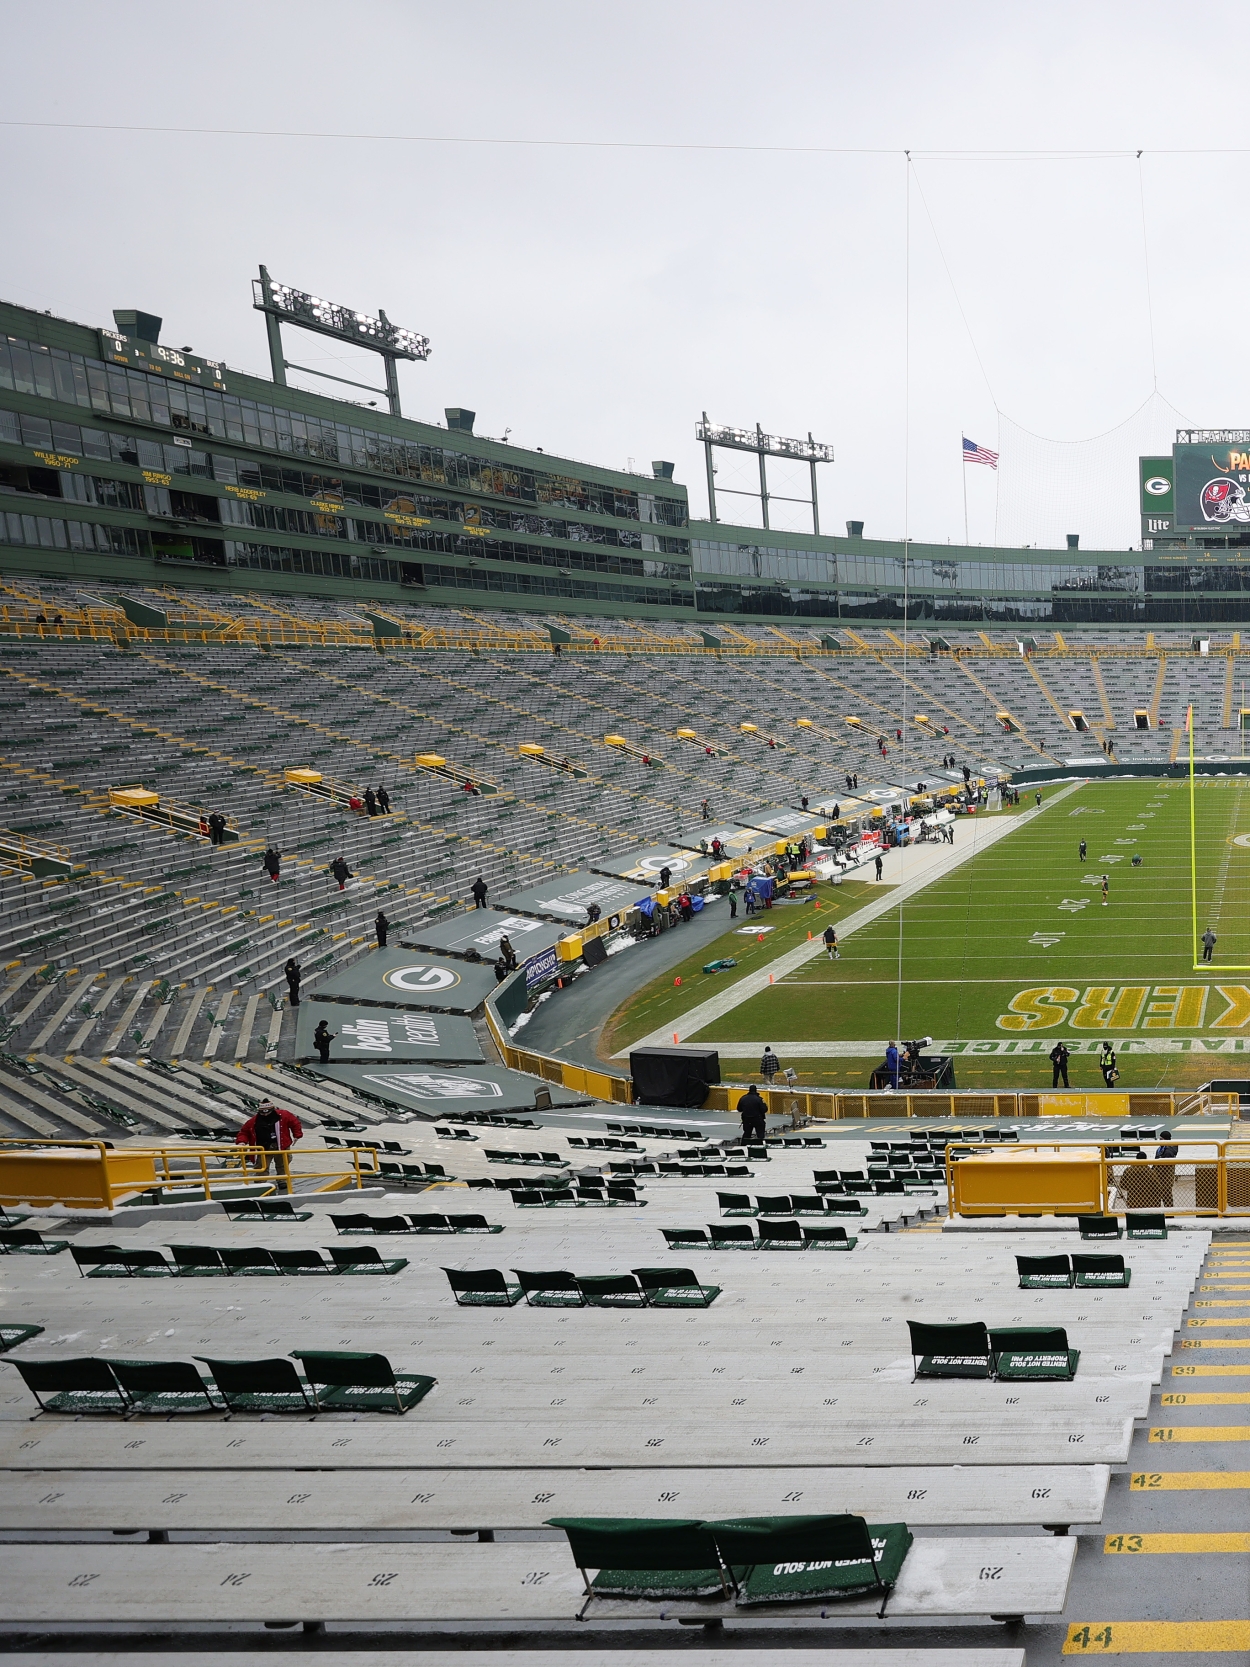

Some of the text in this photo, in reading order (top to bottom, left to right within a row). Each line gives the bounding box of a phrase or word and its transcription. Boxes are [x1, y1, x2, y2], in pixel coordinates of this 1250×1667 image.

[102, 330, 128, 342] PACKERS
[115, 341, 122, 351] 0
[158, 347, 185, 366] 9:36
[206, 360, 219, 369] BUCS
[215, 369, 221, 380] 0
[34, 451, 79, 465] WILLIE WOOD
[44, 458, 71, 469] 1960-71
[152, 472, 172, 481] RINGO
[1239, 474, 1247, 482] VS
[1148, 519, 1170, 533] Lite
[389, 966, 455, 991] G
[342, 1018, 393, 1052] bellin
[390, 1012, 441, 1048] health
[943, 1039, 1146, 1054] JUSTICE
[1008, 1122, 1166, 1133] PACKERS
[1191, 1319, 1207, 1327] 37
[1183, 1340, 1202, 1349] 38
[1174, 1366, 1196, 1376] 39
[1163, 1394, 1187, 1405] 40
[1153, 1429, 1174, 1441] 41
[1134, 1473, 1163, 1488] 42
[657, 1492, 681, 1502] 26
[906, 1490, 928, 1499] 28
[1109, 1535, 1144, 1553] 43
[773, 1560, 832, 1576] NOT SOLD
[978, 1567, 1004, 1580] 29
[1072, 1626, 1113, 1649] 44
